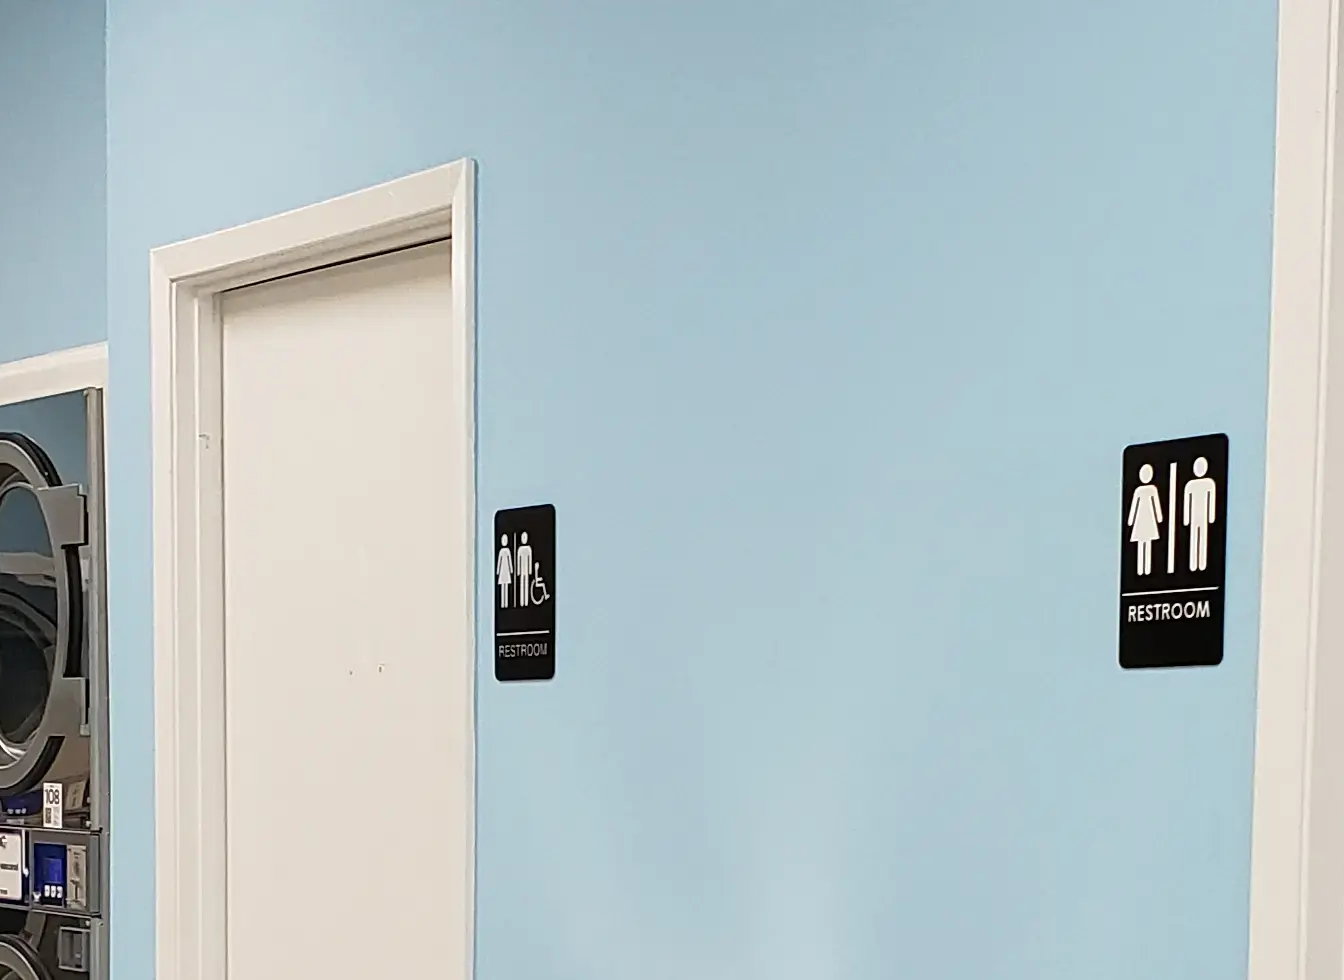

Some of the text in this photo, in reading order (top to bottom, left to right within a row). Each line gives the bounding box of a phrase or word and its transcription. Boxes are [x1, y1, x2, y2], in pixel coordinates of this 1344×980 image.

[1127, 600, 1211, 623] RESTROOM
[498, 642, 548, 658] RESTROOM
[44, 788, 60, 805] 108
